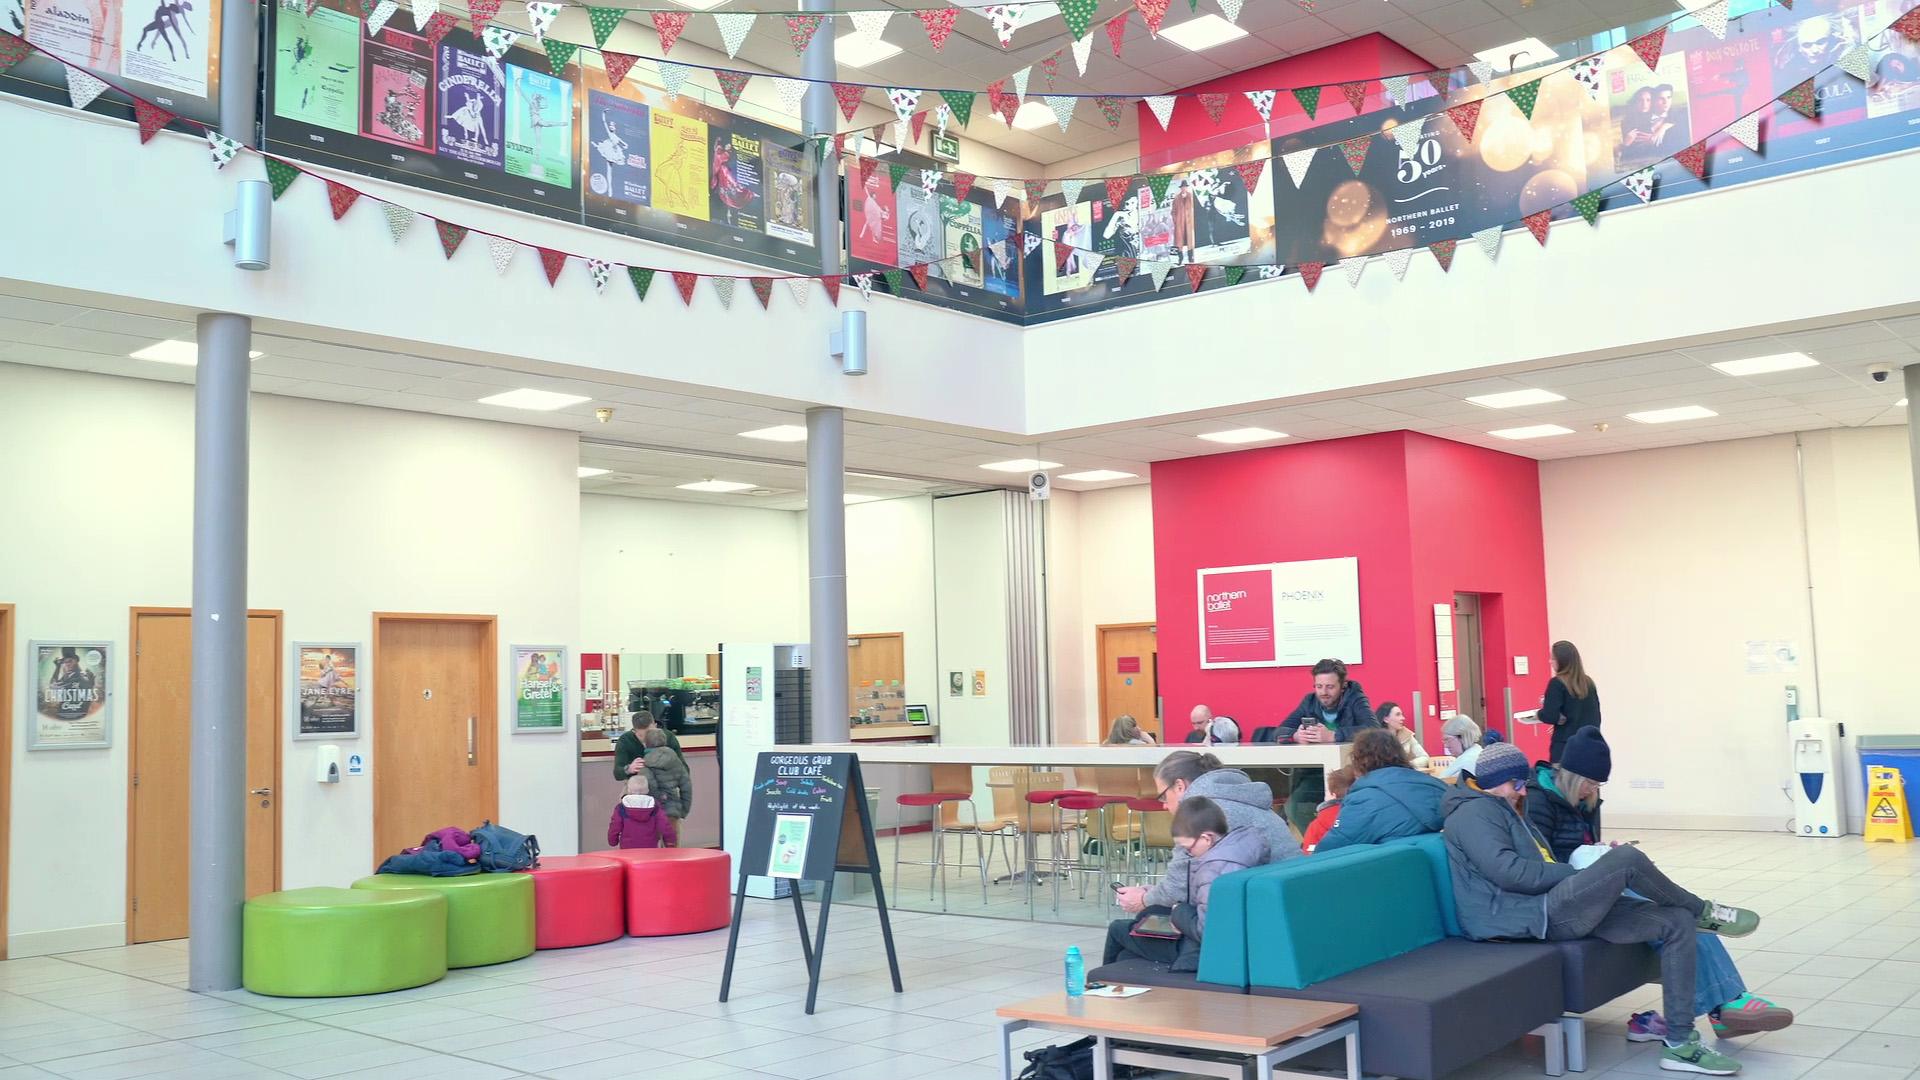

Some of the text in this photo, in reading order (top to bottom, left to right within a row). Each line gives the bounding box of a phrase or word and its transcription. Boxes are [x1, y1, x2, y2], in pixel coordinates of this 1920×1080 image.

[438, 75, 502, 106] CINDERELLA
[1397, 139, 1441, 183] 50
[1385, 203, 1460, 224] NORTHERN BALLET
[1391, 225, 1416, 237] 1969
[1429, 216, 1455, 229] 2019
[1207, 591, 1247, 600] northern
[1281, 590, 1325, 601] PHOENIX
[1207, 601, 1232, 610] ballet
[45, 688, 99, 702] CHRISTMAS
[523, 688, 552, 699] Gretel
[770, 755, 832, 765] GORGEOUS GRUB
[777, 765, 823, 775] CLUB CAFÉ
